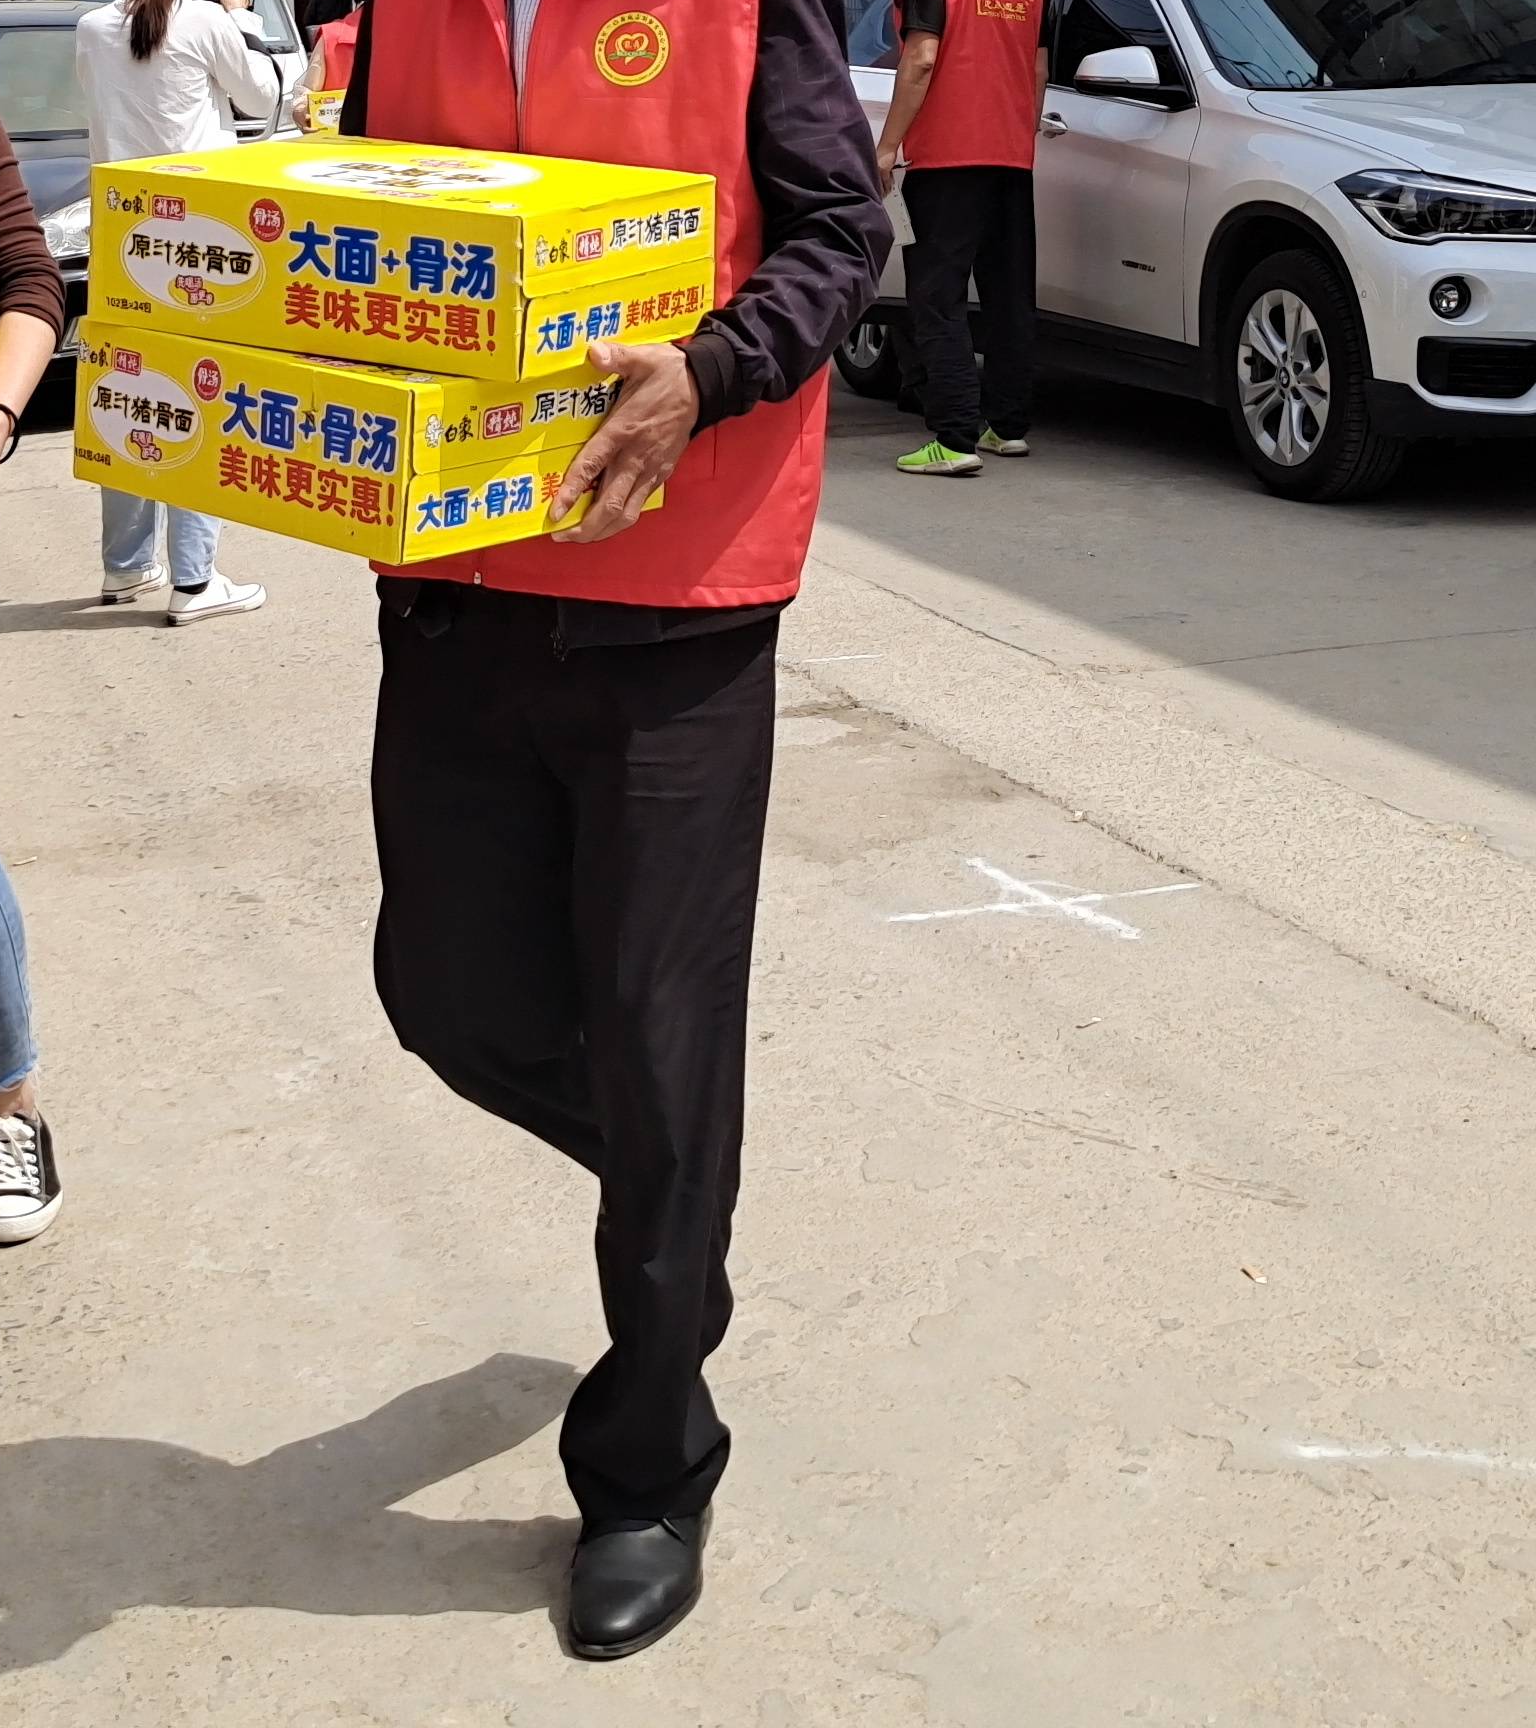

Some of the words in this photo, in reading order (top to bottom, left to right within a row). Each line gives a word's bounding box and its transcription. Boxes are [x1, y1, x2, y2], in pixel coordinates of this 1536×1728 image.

[128, 233, 255, 275] 原汁猪骨面
[287, 220, 497, 300] 大面+骨汤
[610, 207, 702, 248] 原汁猪骨面
[284, 280, 497, 352] 美味更实惠!
[536, 301, 622, 355] 大面+骨汤
[624, 284, 706, 330] 美味更实惠!
[93, 385, 195, 433] 原汁猪骨面
[221, 382, 398, 473] 大面+骨汤
[219, 443, 395, 527] 美味更实惠!
[416, 475, 534, 532] 大面+骨汤
